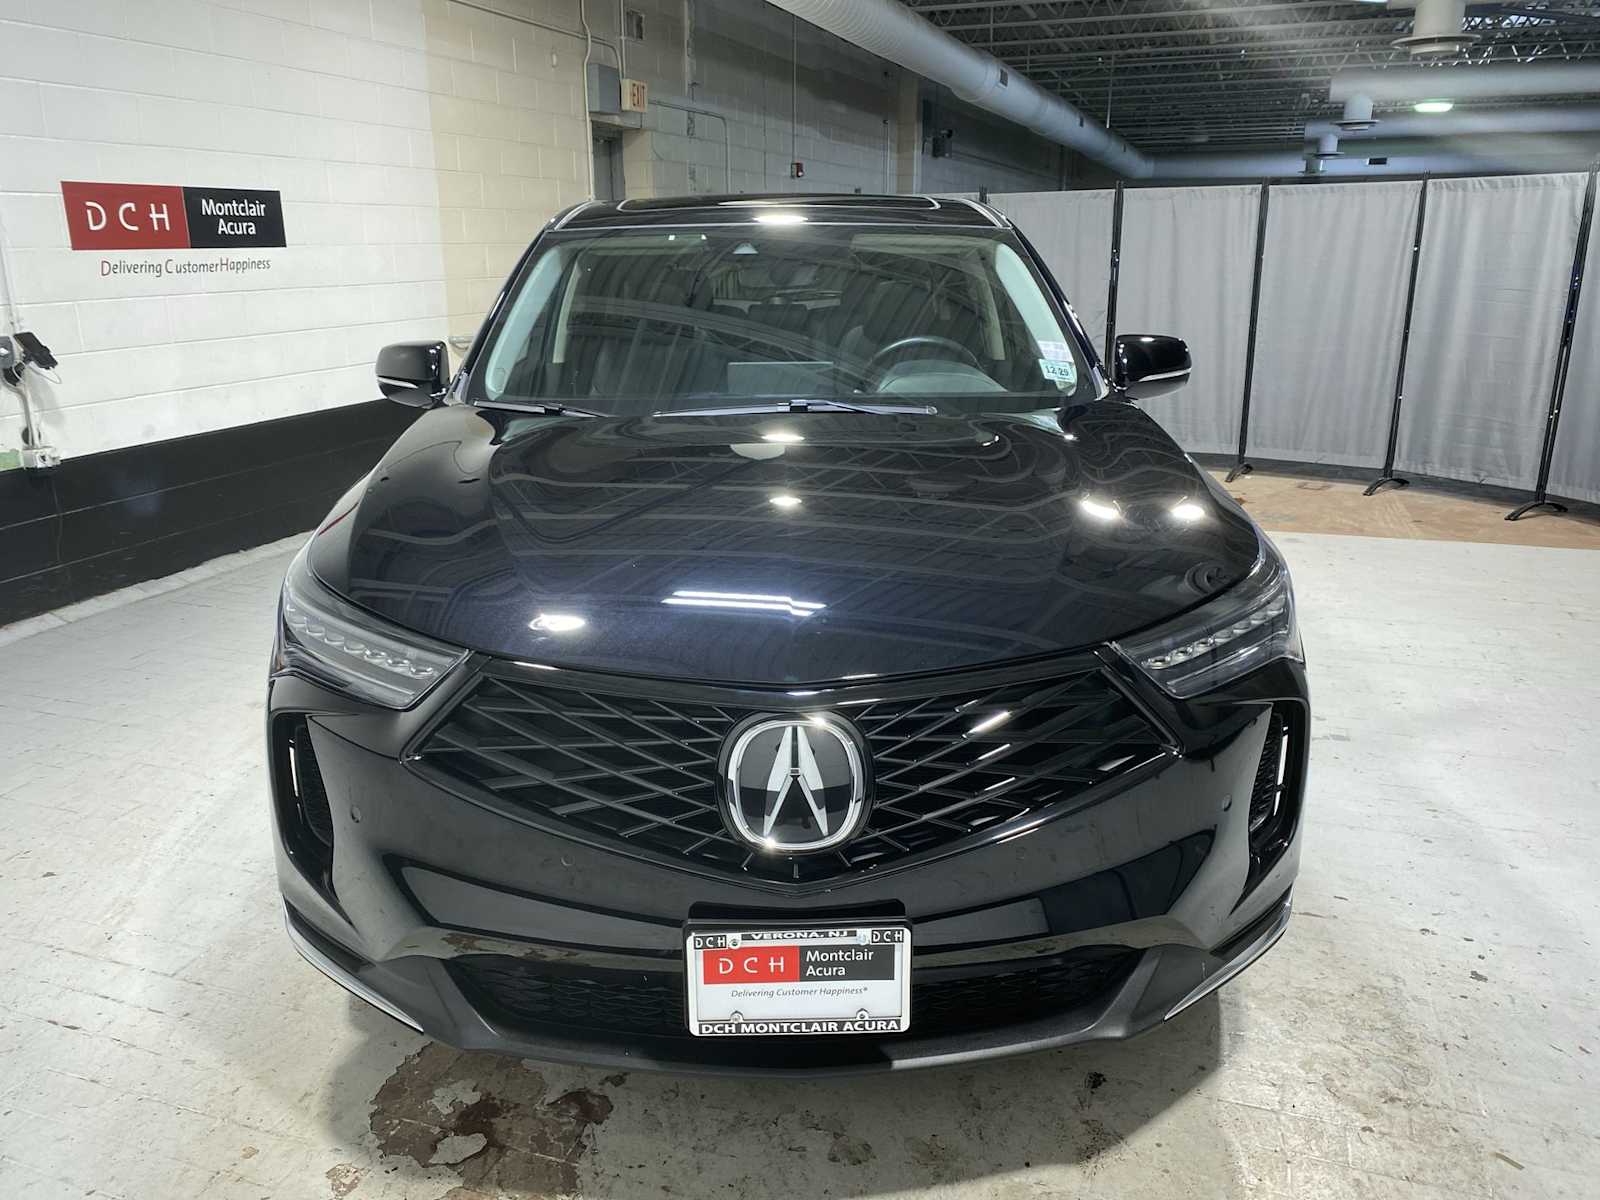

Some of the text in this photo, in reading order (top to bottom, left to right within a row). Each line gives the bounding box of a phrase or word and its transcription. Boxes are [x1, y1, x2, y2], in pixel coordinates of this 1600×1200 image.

[632, 83, 645, 106] EXIT
[201, 199, 266, 217] Montclair
[85, 201, 170, 231] DCH
[217, 218, 257, 235] Acura
[101, 260, 162, 278] Delivering
[828, 930, 848, 938] NJ
[872, 930, 904, 942] DCH
[694, 937, 726, 949] DCH
[806, 949, 874, 962] Montclair
[719, 956, 784, 974] DCH
[806, 965, 846, 977] Acura
[731, 989, 774, 998] Delivering
[776, 988, 817, 997] Customer
[701, 1020, 899, 1035] DCH MONTCLAIR ACURA
